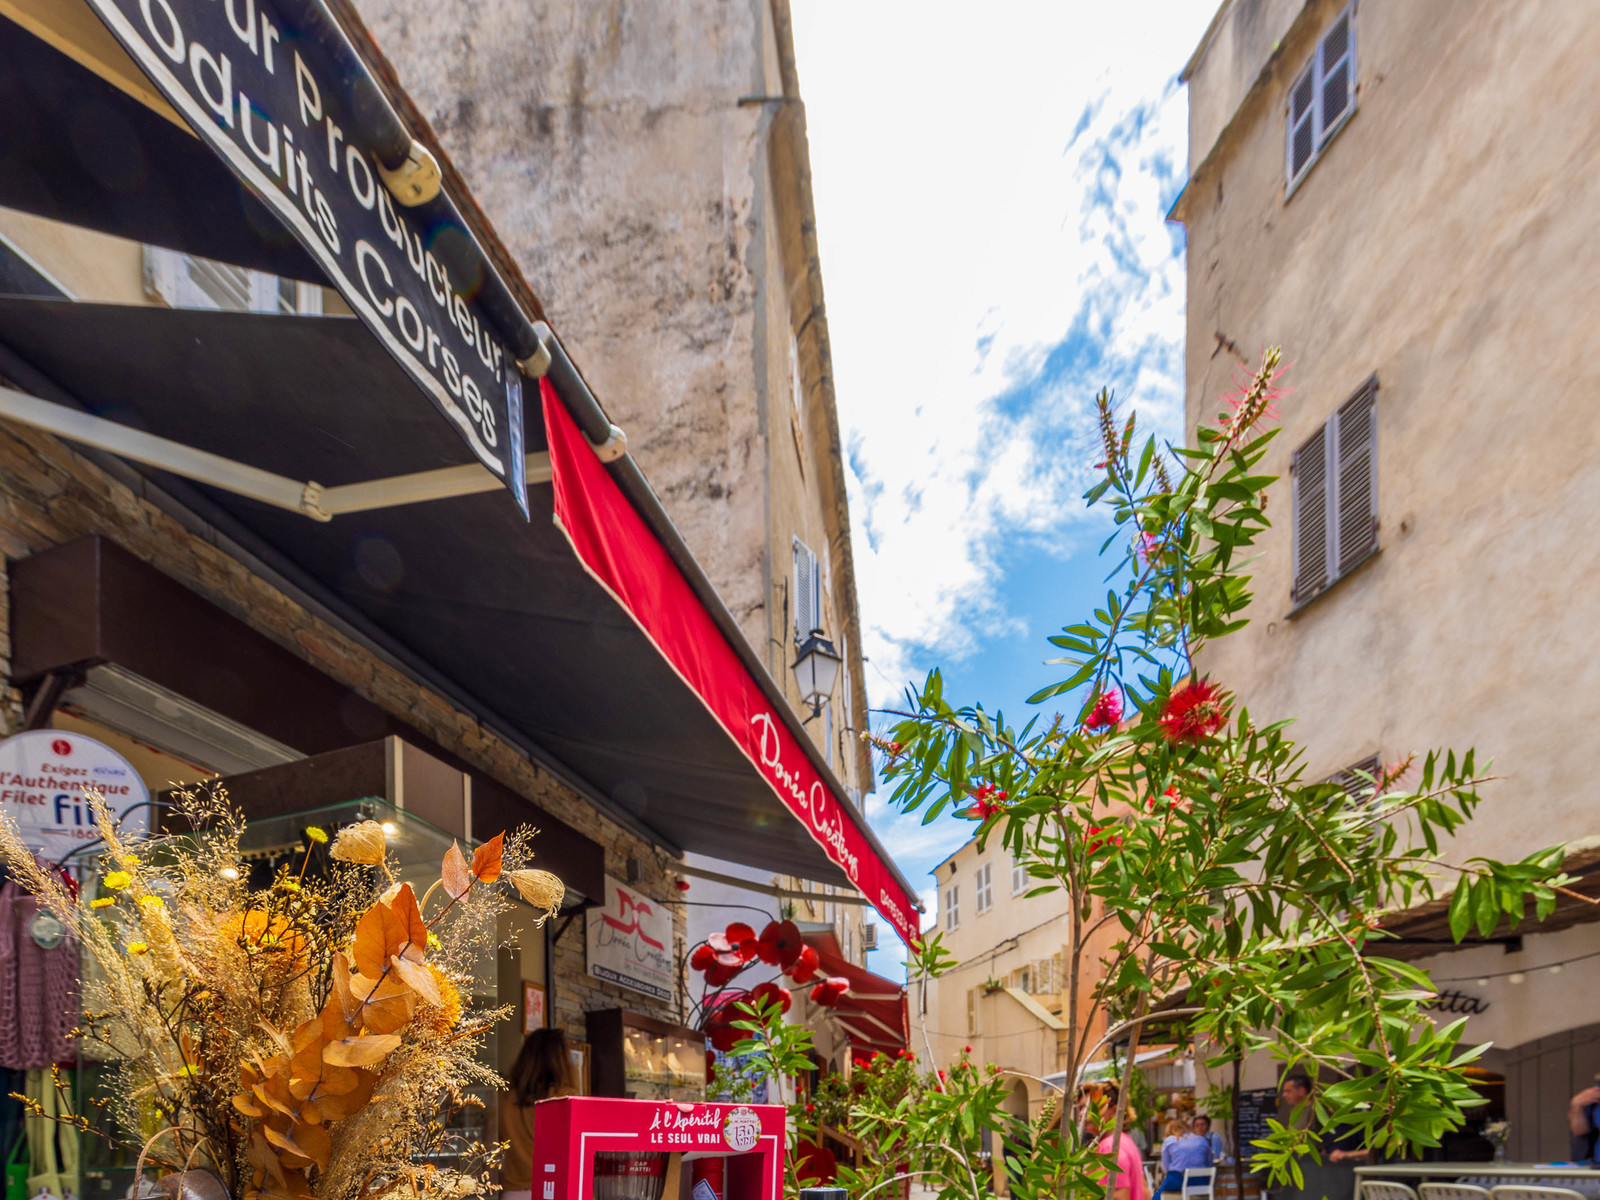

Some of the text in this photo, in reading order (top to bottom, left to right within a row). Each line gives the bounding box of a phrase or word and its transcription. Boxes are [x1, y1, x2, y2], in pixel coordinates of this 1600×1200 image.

[355, 238, 497, 449] Corses
[41, 763, 88, 777] Exigez
[0, 771, 130, 796] l'Authentique
[1, 790, 47, 806] Filet
[54, 794, 116, 827] fil
[664, 1108, 721, 1131] l'Apéritif
[651, 1133, 721, 1144] LE SEUL VRAI
